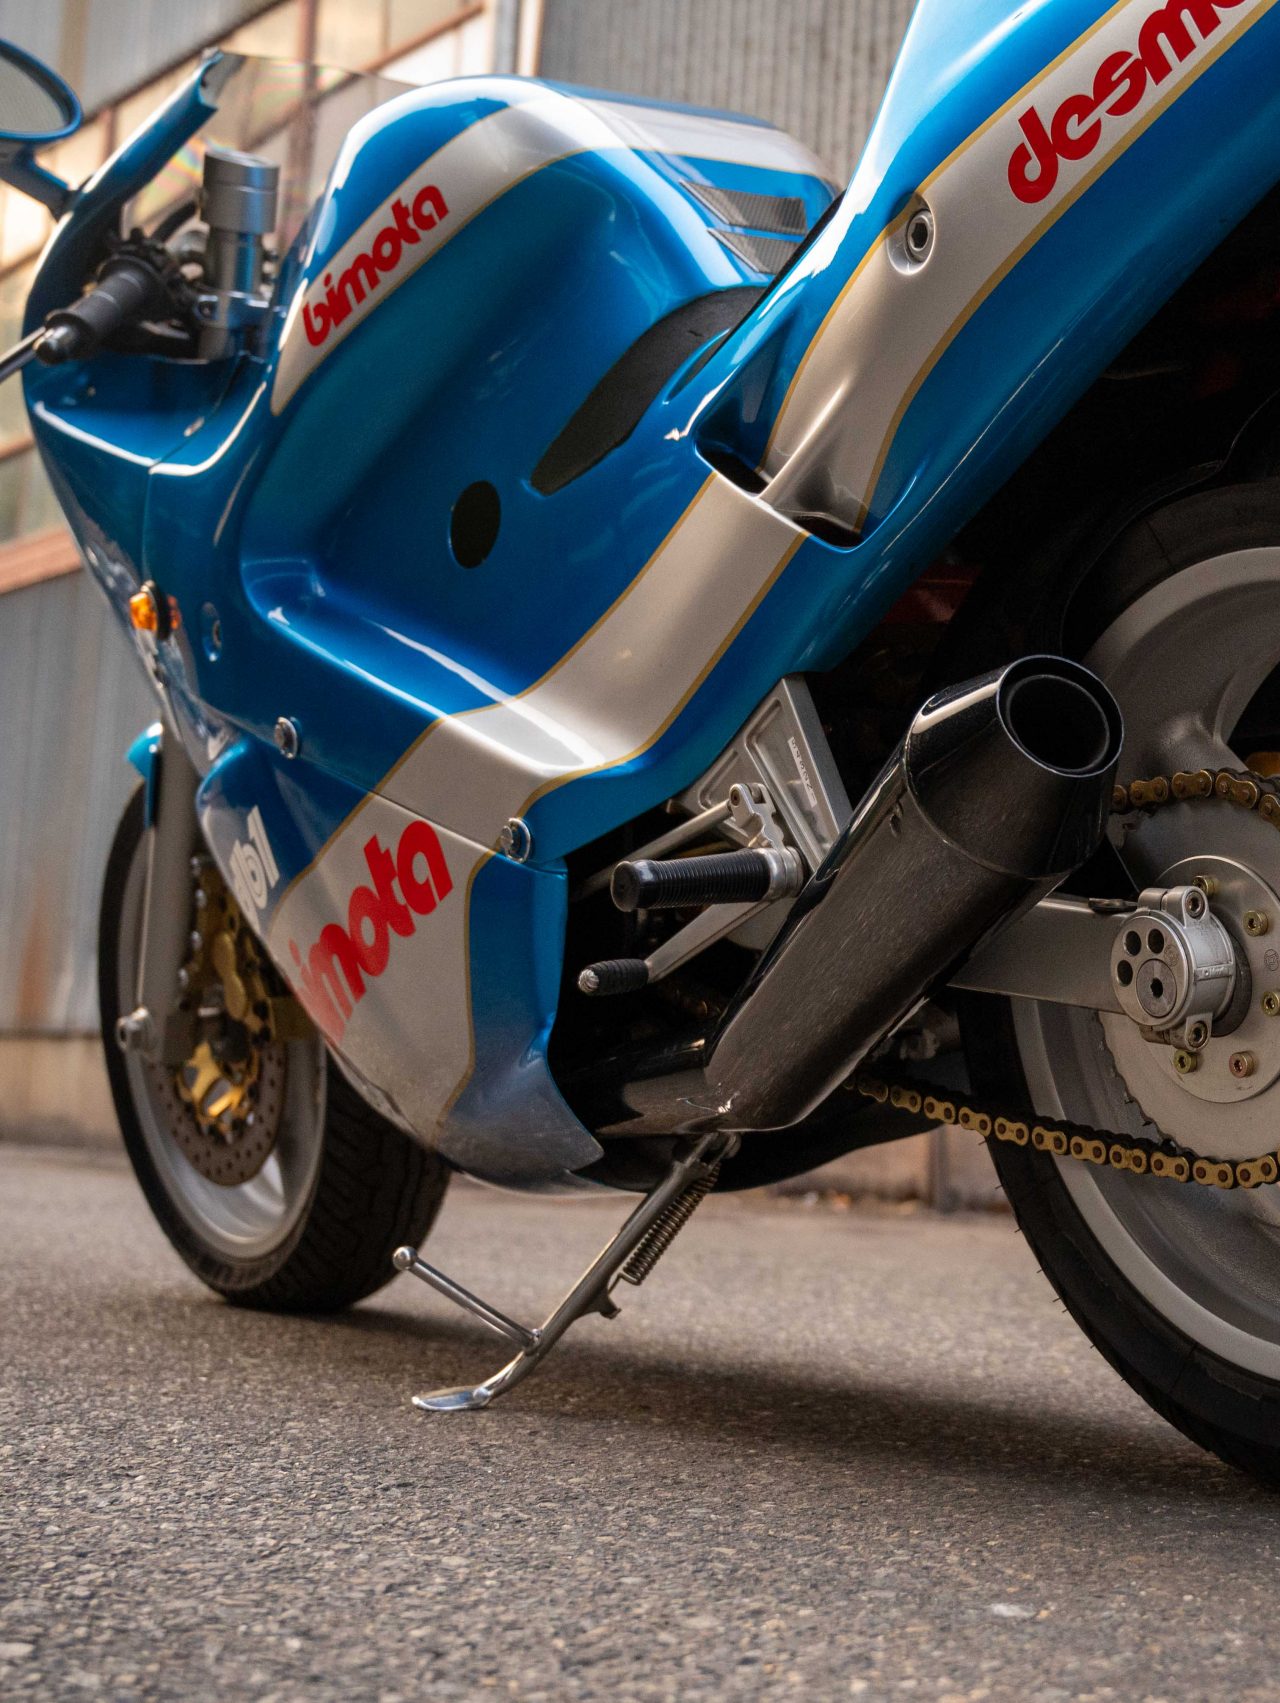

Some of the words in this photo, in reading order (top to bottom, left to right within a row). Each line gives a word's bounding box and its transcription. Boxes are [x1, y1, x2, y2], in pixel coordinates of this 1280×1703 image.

[1007, 0, 1247, 204] desm
[303, 185, 449, 347] bimota
[287, 820, 453, 1045] imota
